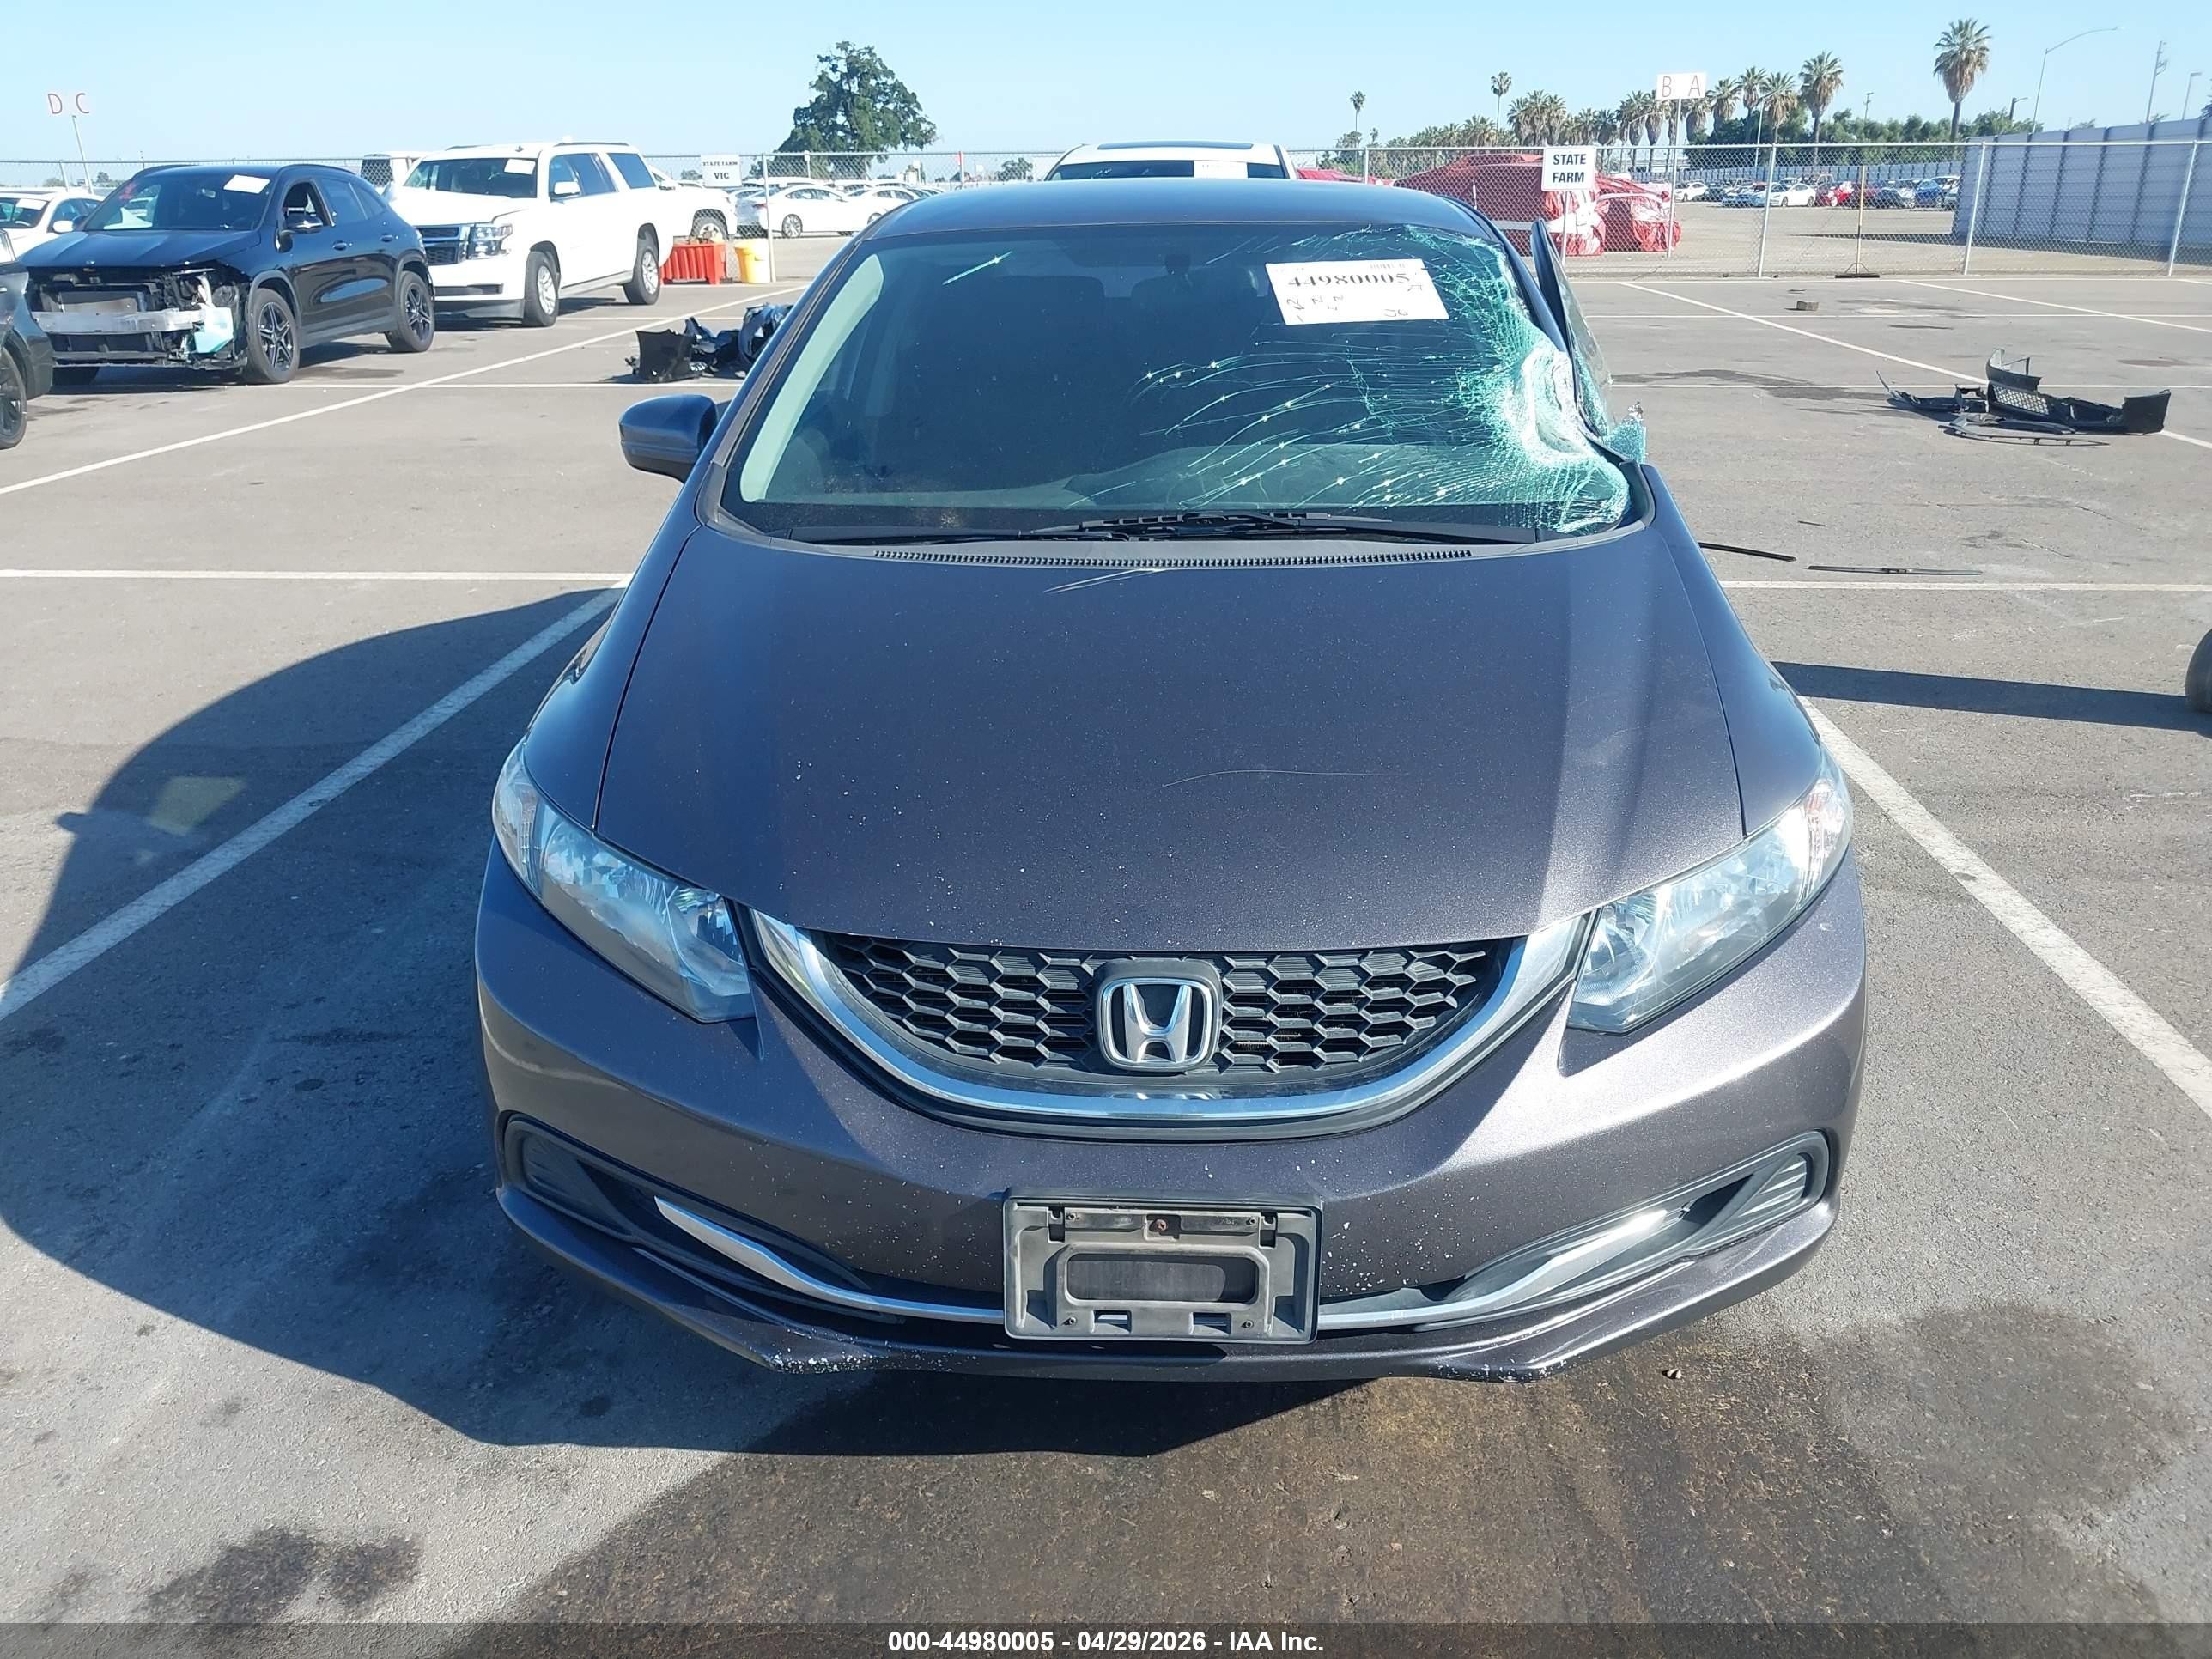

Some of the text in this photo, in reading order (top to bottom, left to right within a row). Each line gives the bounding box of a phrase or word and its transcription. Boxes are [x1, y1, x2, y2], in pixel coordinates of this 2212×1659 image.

[1662, 75, 1701, 98] B A
[47, 92, 90, 114] D C
[1553, 153, 1587, 166] STATE
[1552, 172, 1585, 184] FARM
[1288, 272, 1411, 288] 44980005
